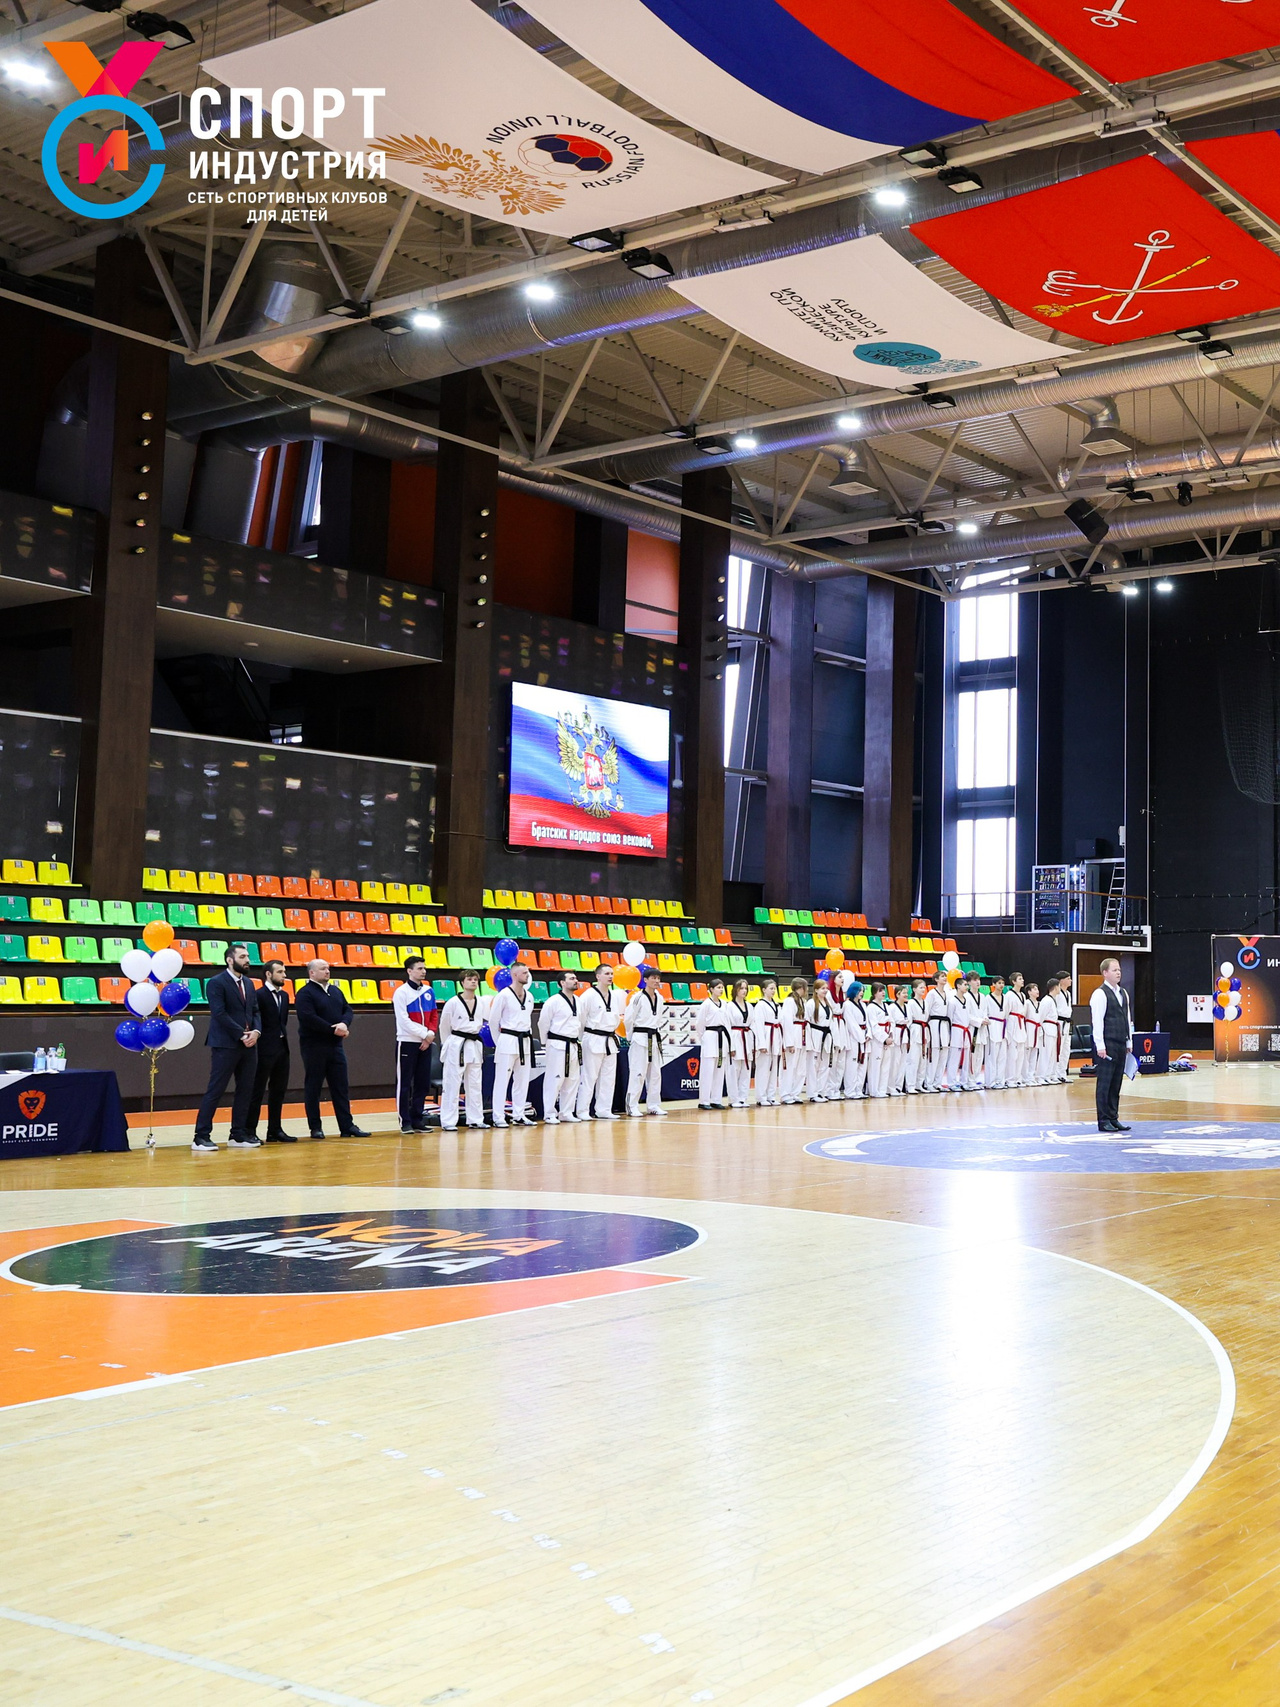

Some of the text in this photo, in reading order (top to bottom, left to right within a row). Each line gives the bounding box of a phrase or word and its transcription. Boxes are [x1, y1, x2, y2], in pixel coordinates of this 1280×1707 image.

[486, 114, 645, 189] RUSSIAN FOOTBALL UNION
[770, 291, 843, 342] КОМИТЕТ ПО
[781, 287, 856, 341] ФИЗИЧЕСКОЙ
[818, 303, 873, 338] КУЛЬТУРЕ
[830, 298, 889, 336] И СПОРТУ
[531, 822, 568, 841] Братских
[569, 830, 601, 844] народов
[602, 834, 621, 845] союз
[1140, 1055, 1155, 1063] PRIDE
[681, 1079, 700, 1088] PRID
[3, 1123, 58, 1139] PRIDE
[150, 1232, 505, 1275] ARENA
[278, 1218, 564, 1257] NOVA
